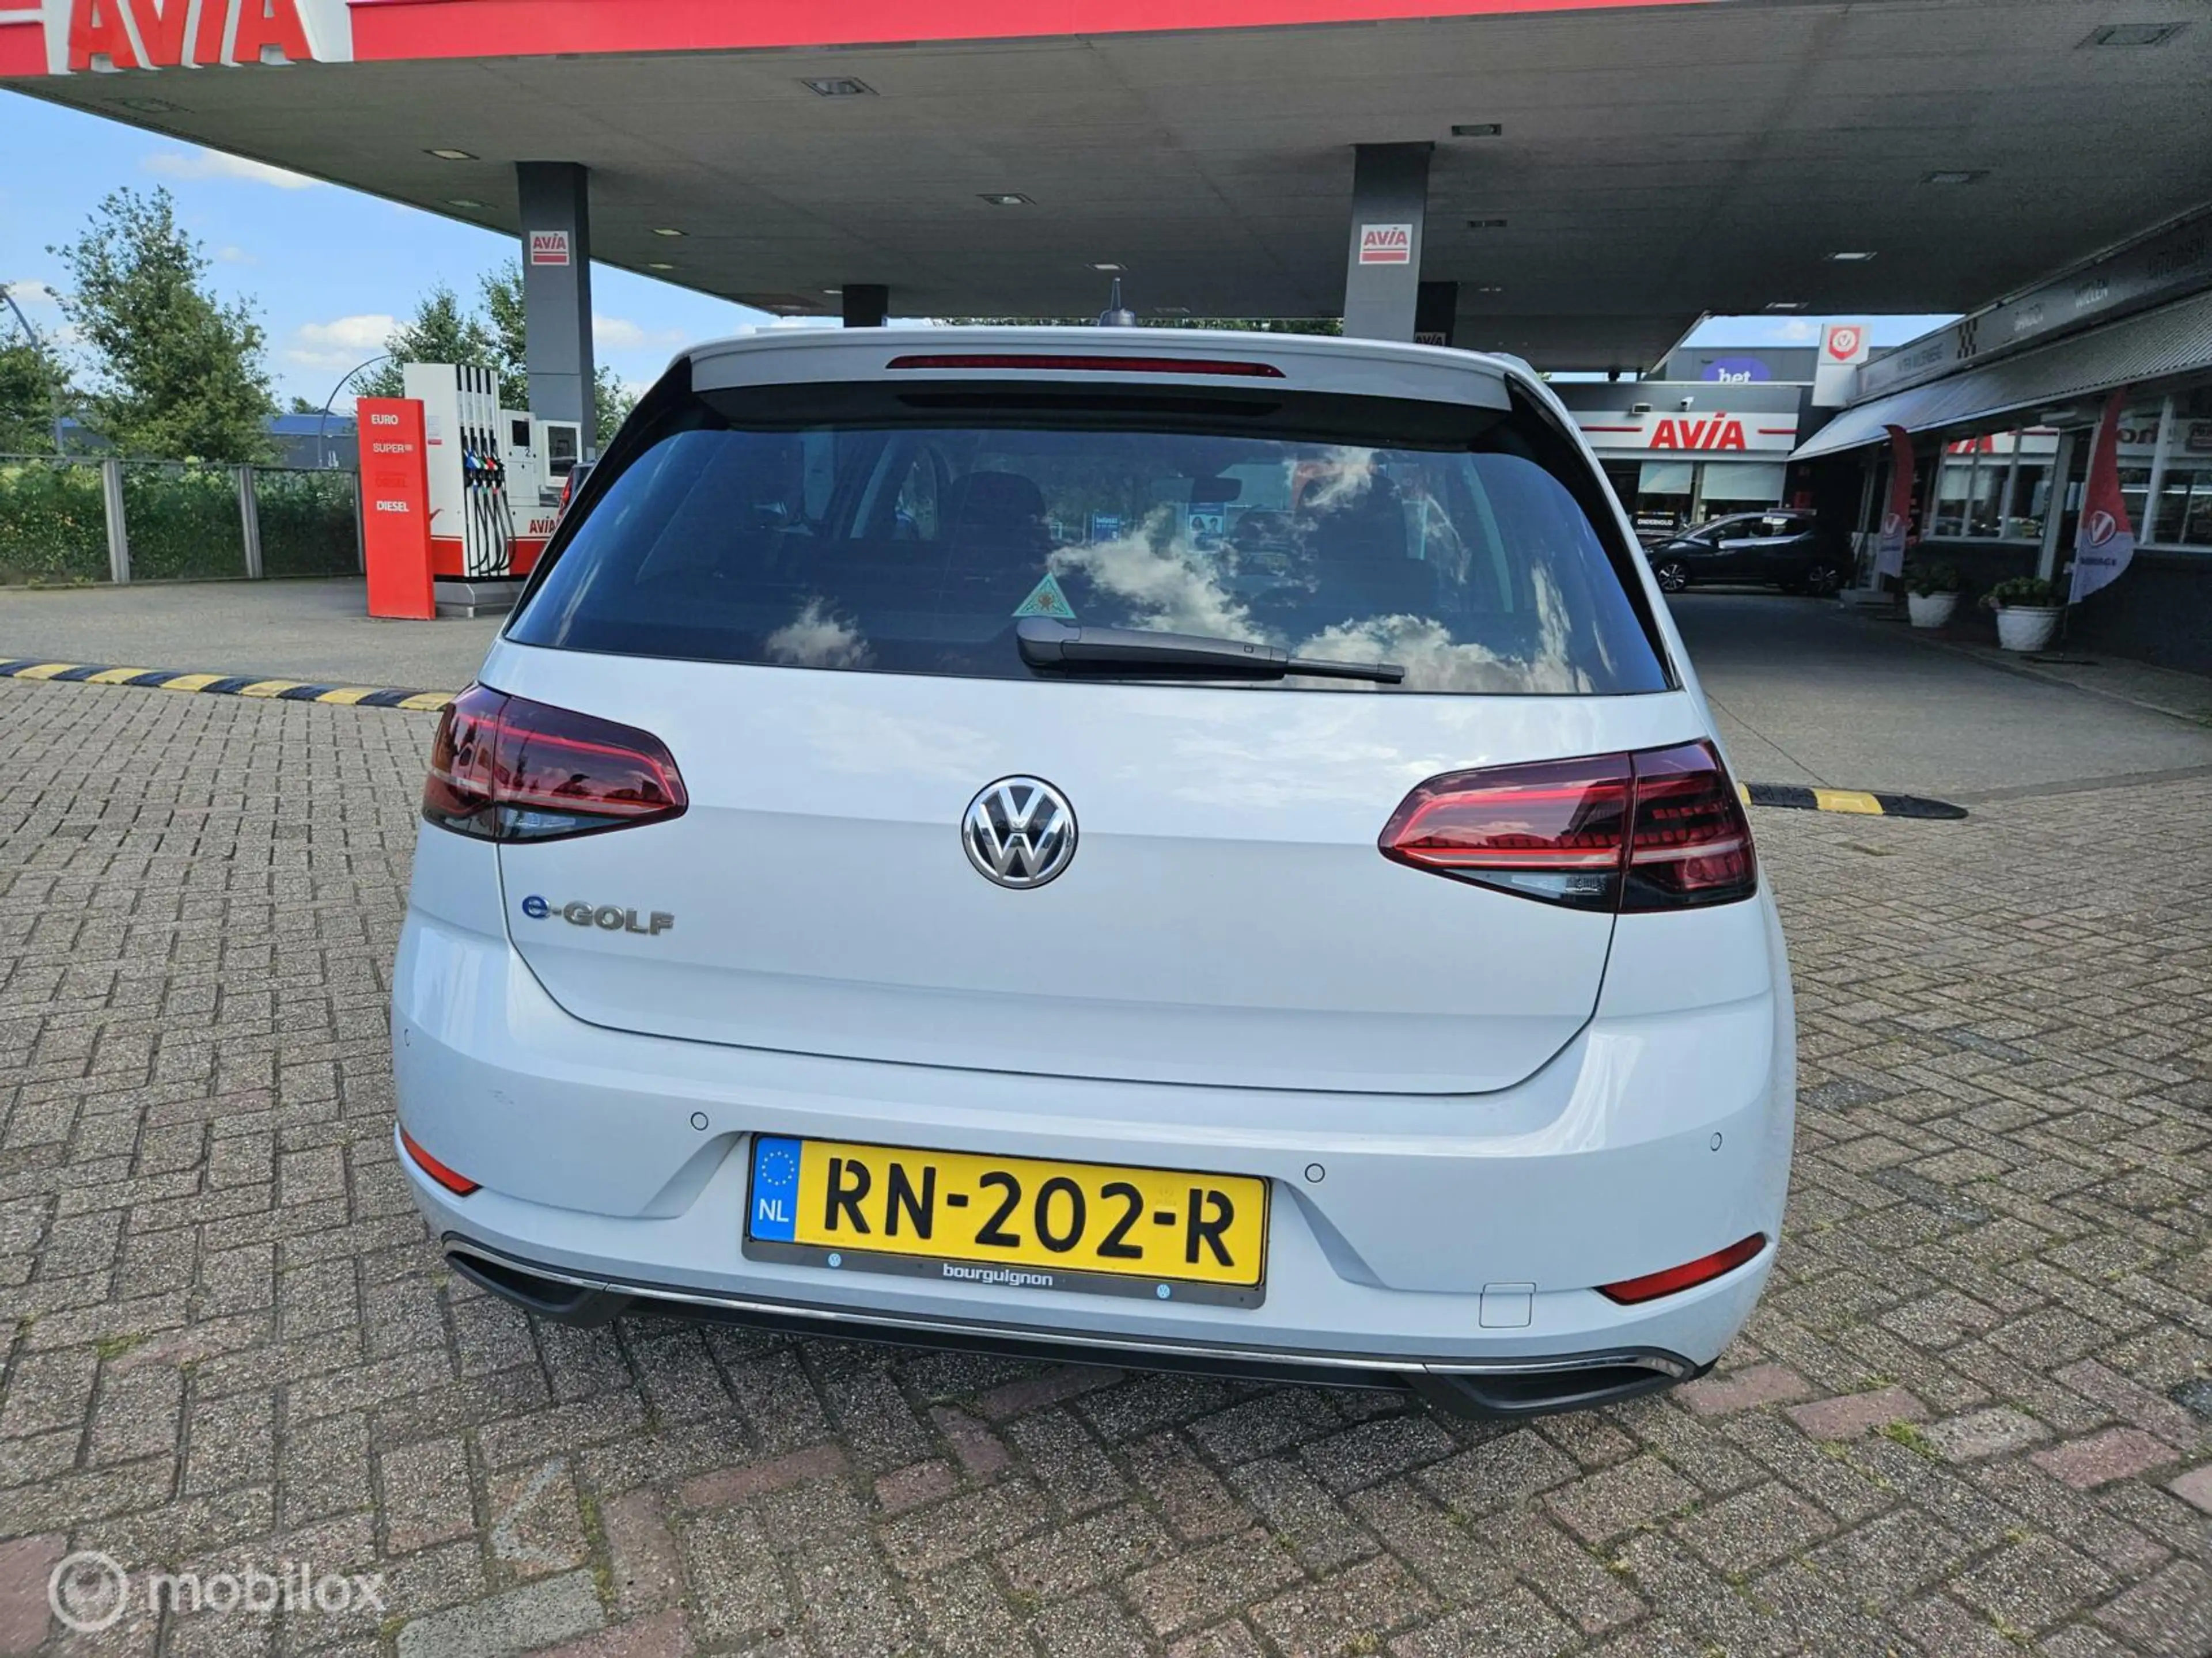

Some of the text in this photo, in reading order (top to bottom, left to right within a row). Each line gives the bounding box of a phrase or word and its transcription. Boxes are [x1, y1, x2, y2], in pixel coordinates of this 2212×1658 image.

[67, 0, 315, 70] AVIA
[533, 233, 566, 249] AVIA
[1363, 227, 1408, 245] AVIA
[372, 415, 398, 425] EURO
[1649, 411, 1747, 450] AVIA
[373, 443, 405, 453] SUPER
[525, 448, 531, 457] 2
[377, 501, 410, 512] DIESEL
[529, 519, 556, 533] AVIA
[522, 896, 675, 935] e-GOLF
[759, 1198, 789, 1222] NL
[824, 1158, 1234, 1267] RN-202-R
[943, 1263, 1053, 1286] bourguignon
